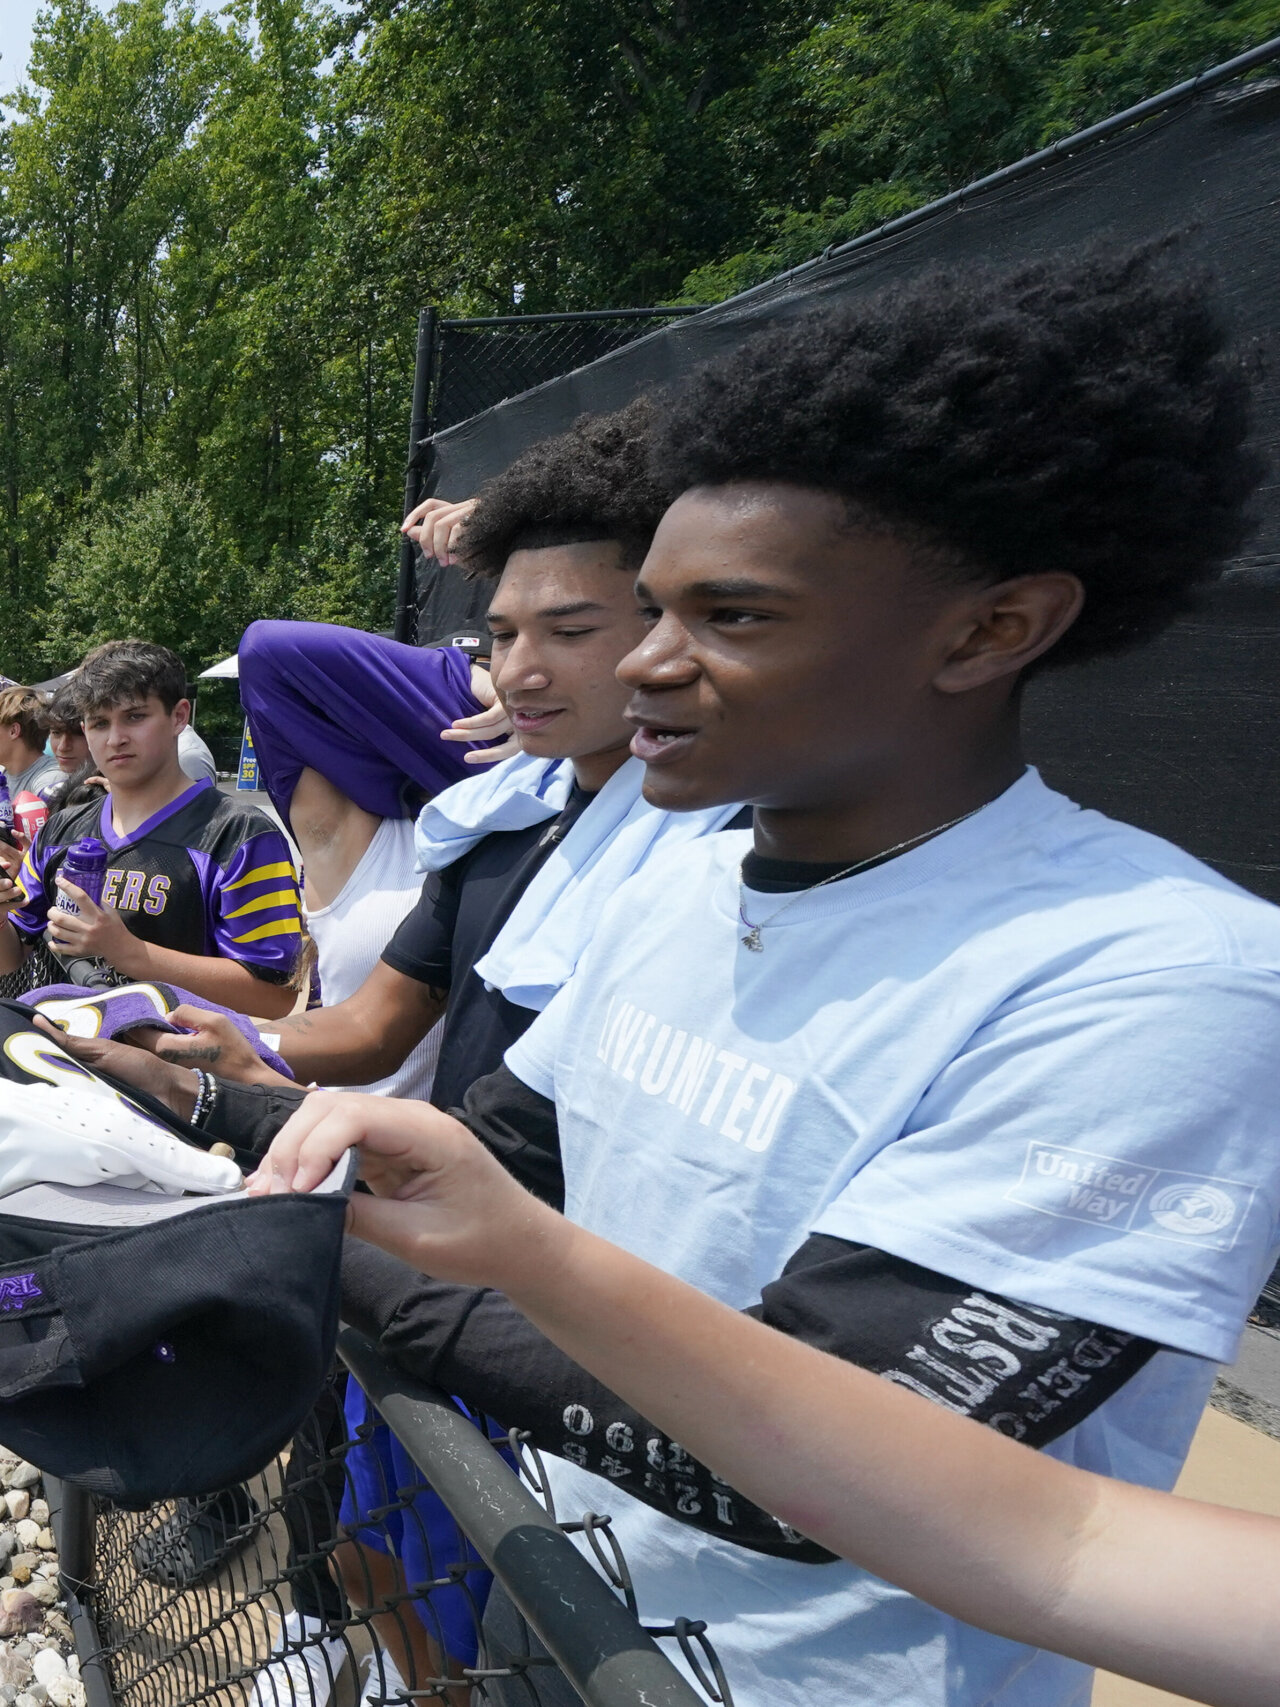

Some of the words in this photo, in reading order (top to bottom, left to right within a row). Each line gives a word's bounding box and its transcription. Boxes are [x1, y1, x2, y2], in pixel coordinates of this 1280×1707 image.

[242, 770, 255, 778] 30
[1035, 1150, 1148, 1196] United
[1066, 1184, 1130, 1222] Way
